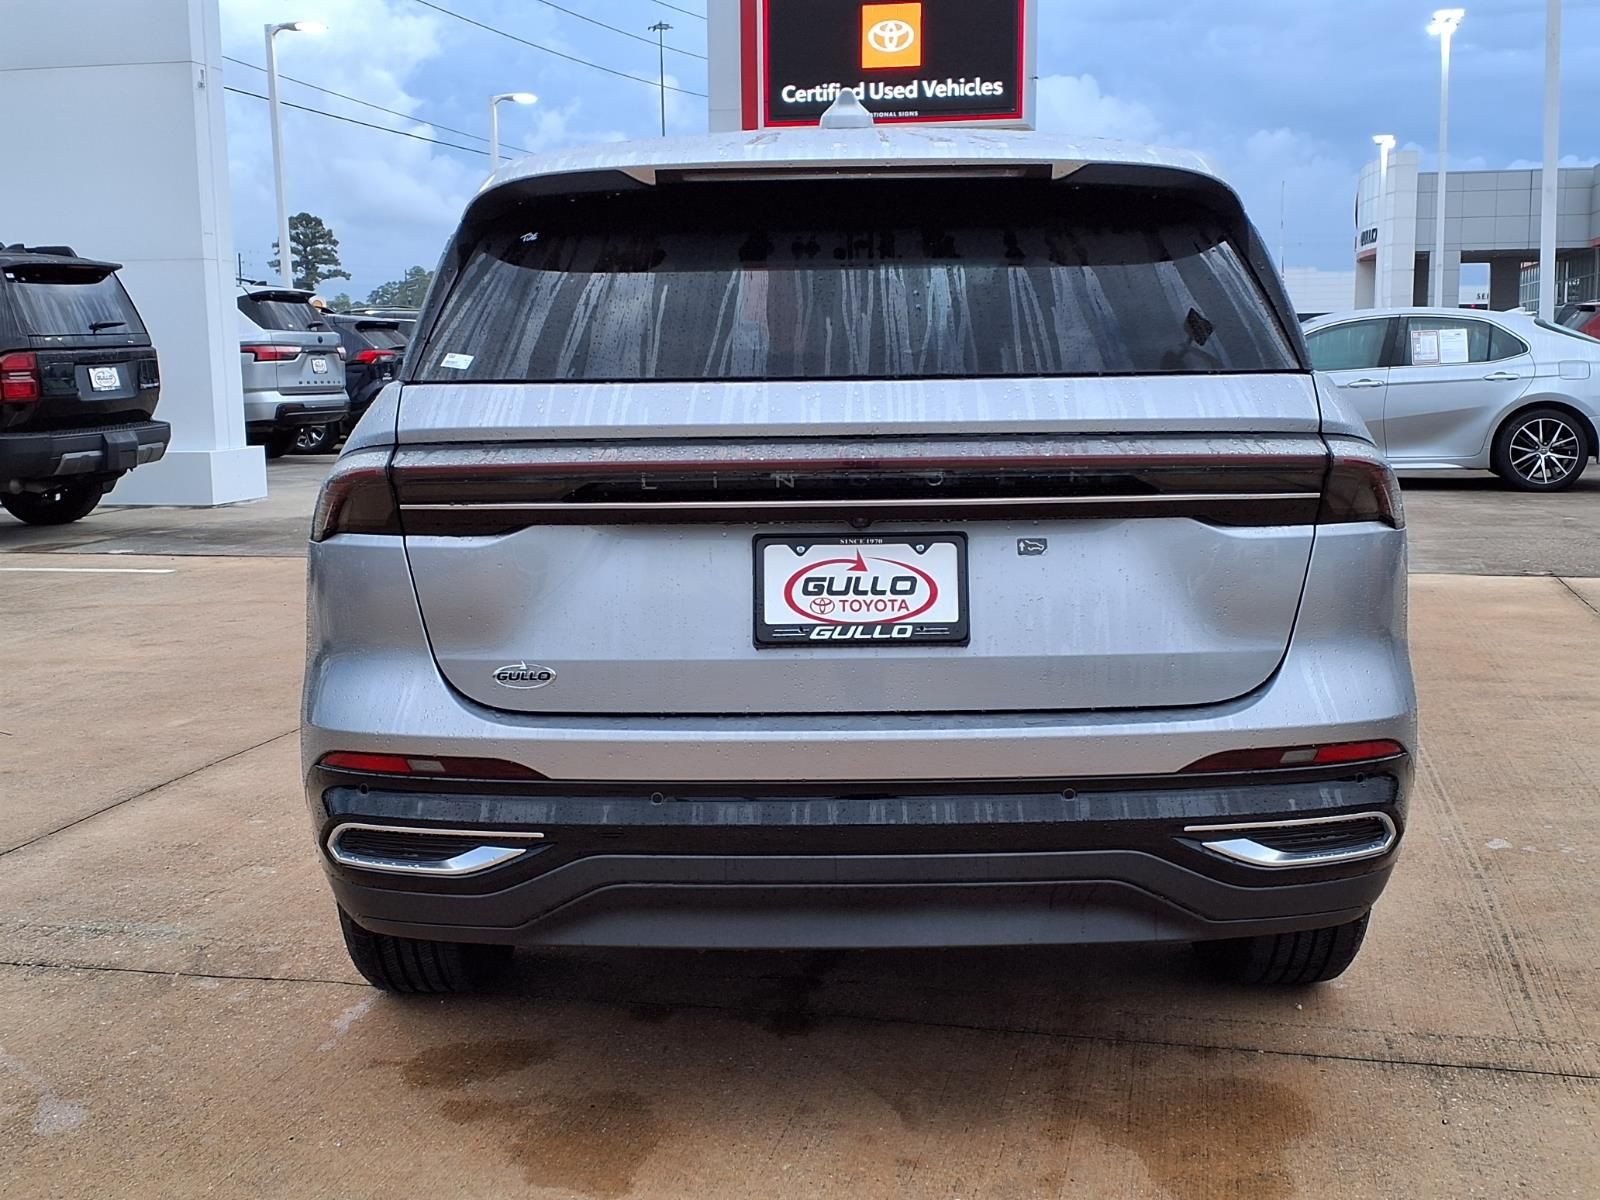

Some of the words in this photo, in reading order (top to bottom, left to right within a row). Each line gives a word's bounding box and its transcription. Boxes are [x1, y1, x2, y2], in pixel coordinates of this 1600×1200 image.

[781, 82, 865, 103] Certifid
[869, 80, 918, 100] Used
[921, 77, 1004, 98] Vehicles
[802, 575, 918, 597] GULLO
[838, 599, 910, 613] TOYOTA
[809, 625, 913, 640] GULLO
[496, 671, 551, 681] GULLO
